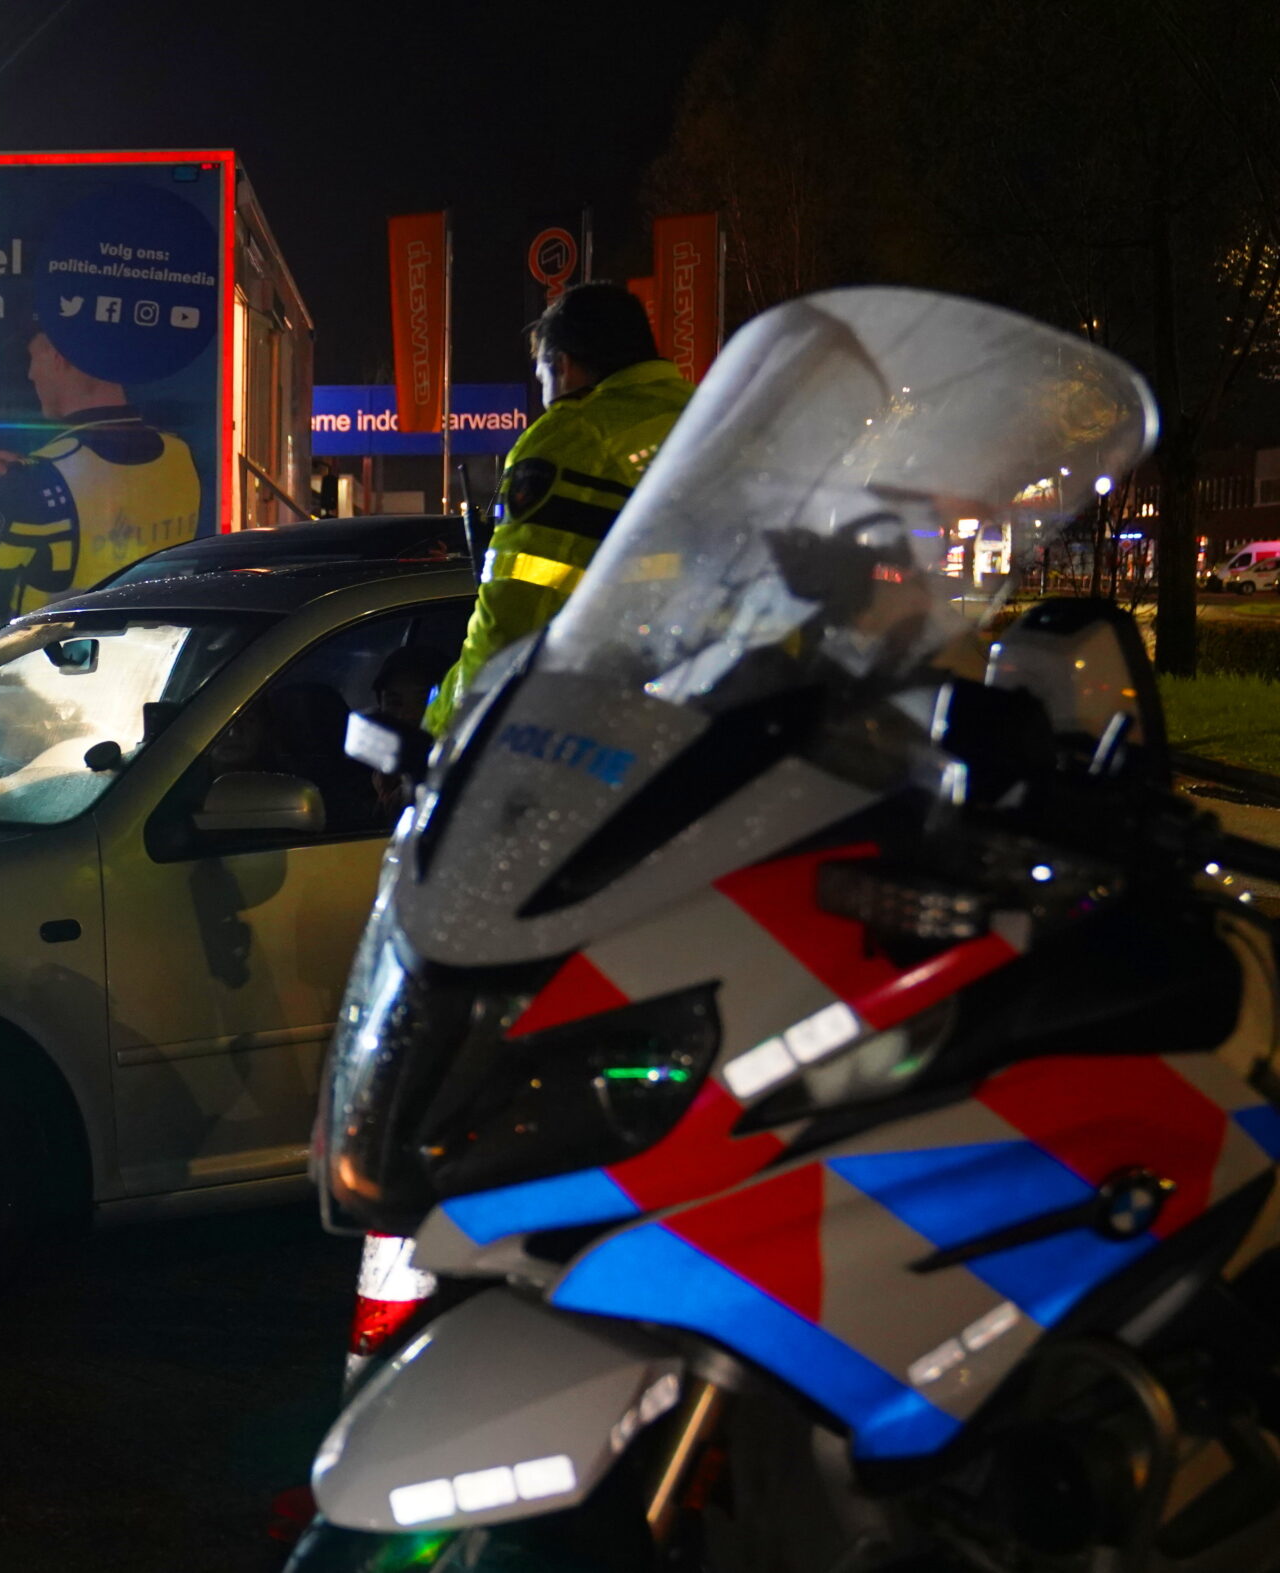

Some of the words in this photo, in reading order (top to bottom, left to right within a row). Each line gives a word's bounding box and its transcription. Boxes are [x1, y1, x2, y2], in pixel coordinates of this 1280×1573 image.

[99, 242, 133, 261] Volg
[136, 247, 170, 261] ons:
[48, 257, 216, 287] politie.nl/socialmedia
